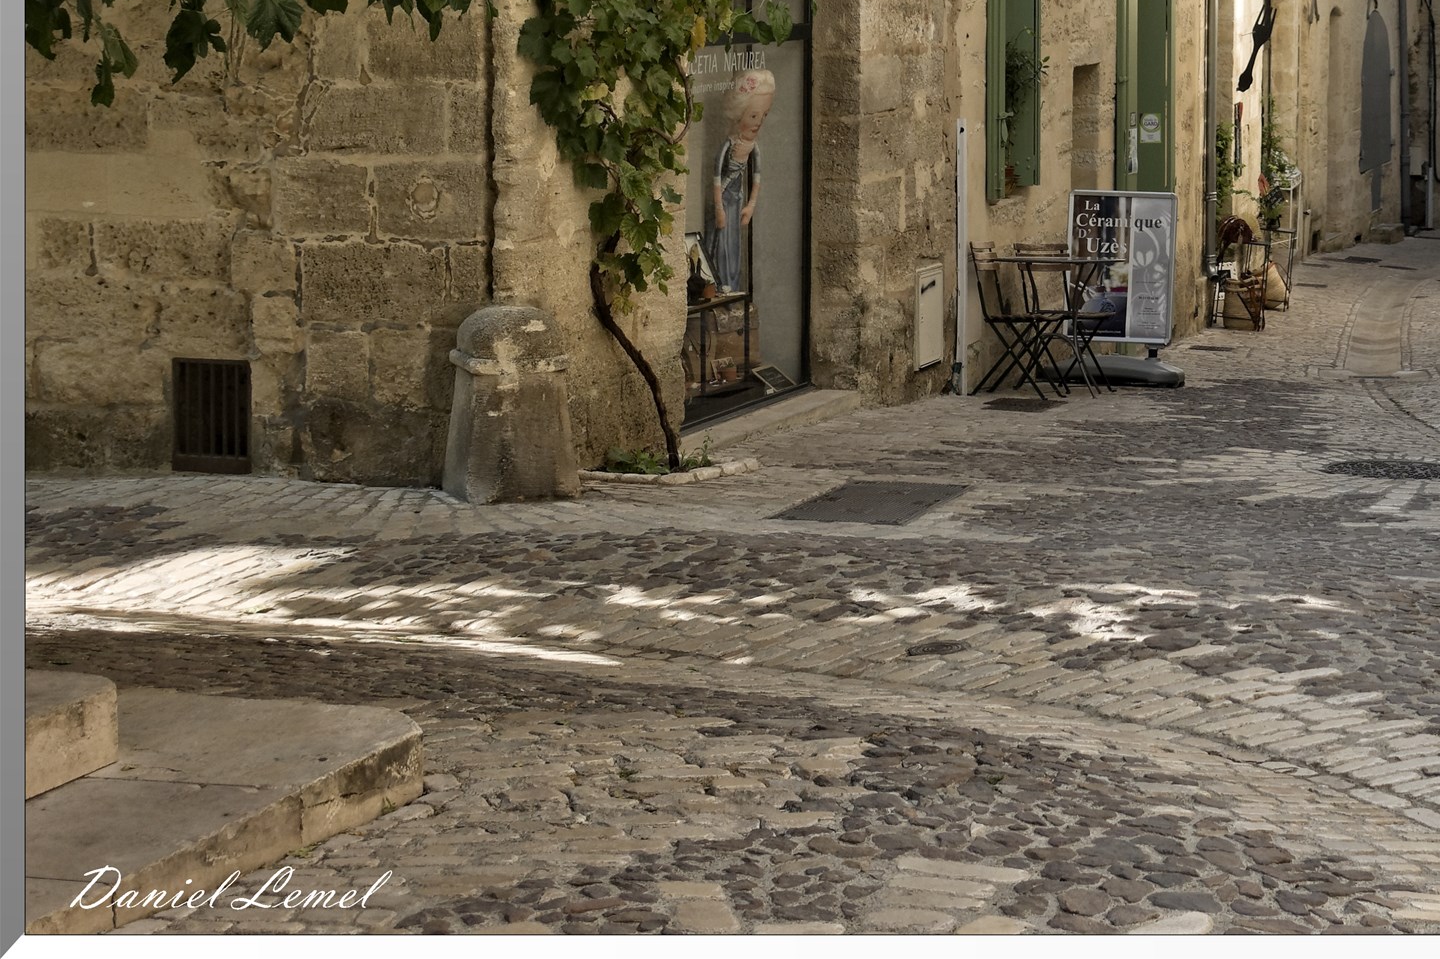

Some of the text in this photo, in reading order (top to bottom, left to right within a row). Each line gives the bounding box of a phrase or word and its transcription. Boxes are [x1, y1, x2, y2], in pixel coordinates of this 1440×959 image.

[723, 51, 766, 71] NATUREA
[1085, 200, 1100, 211] La
[1076, 212, 1162, 232] Céramique
[1078, 228, 1092, 239] D'
[1086, 237, 1128, 254] Uzès
